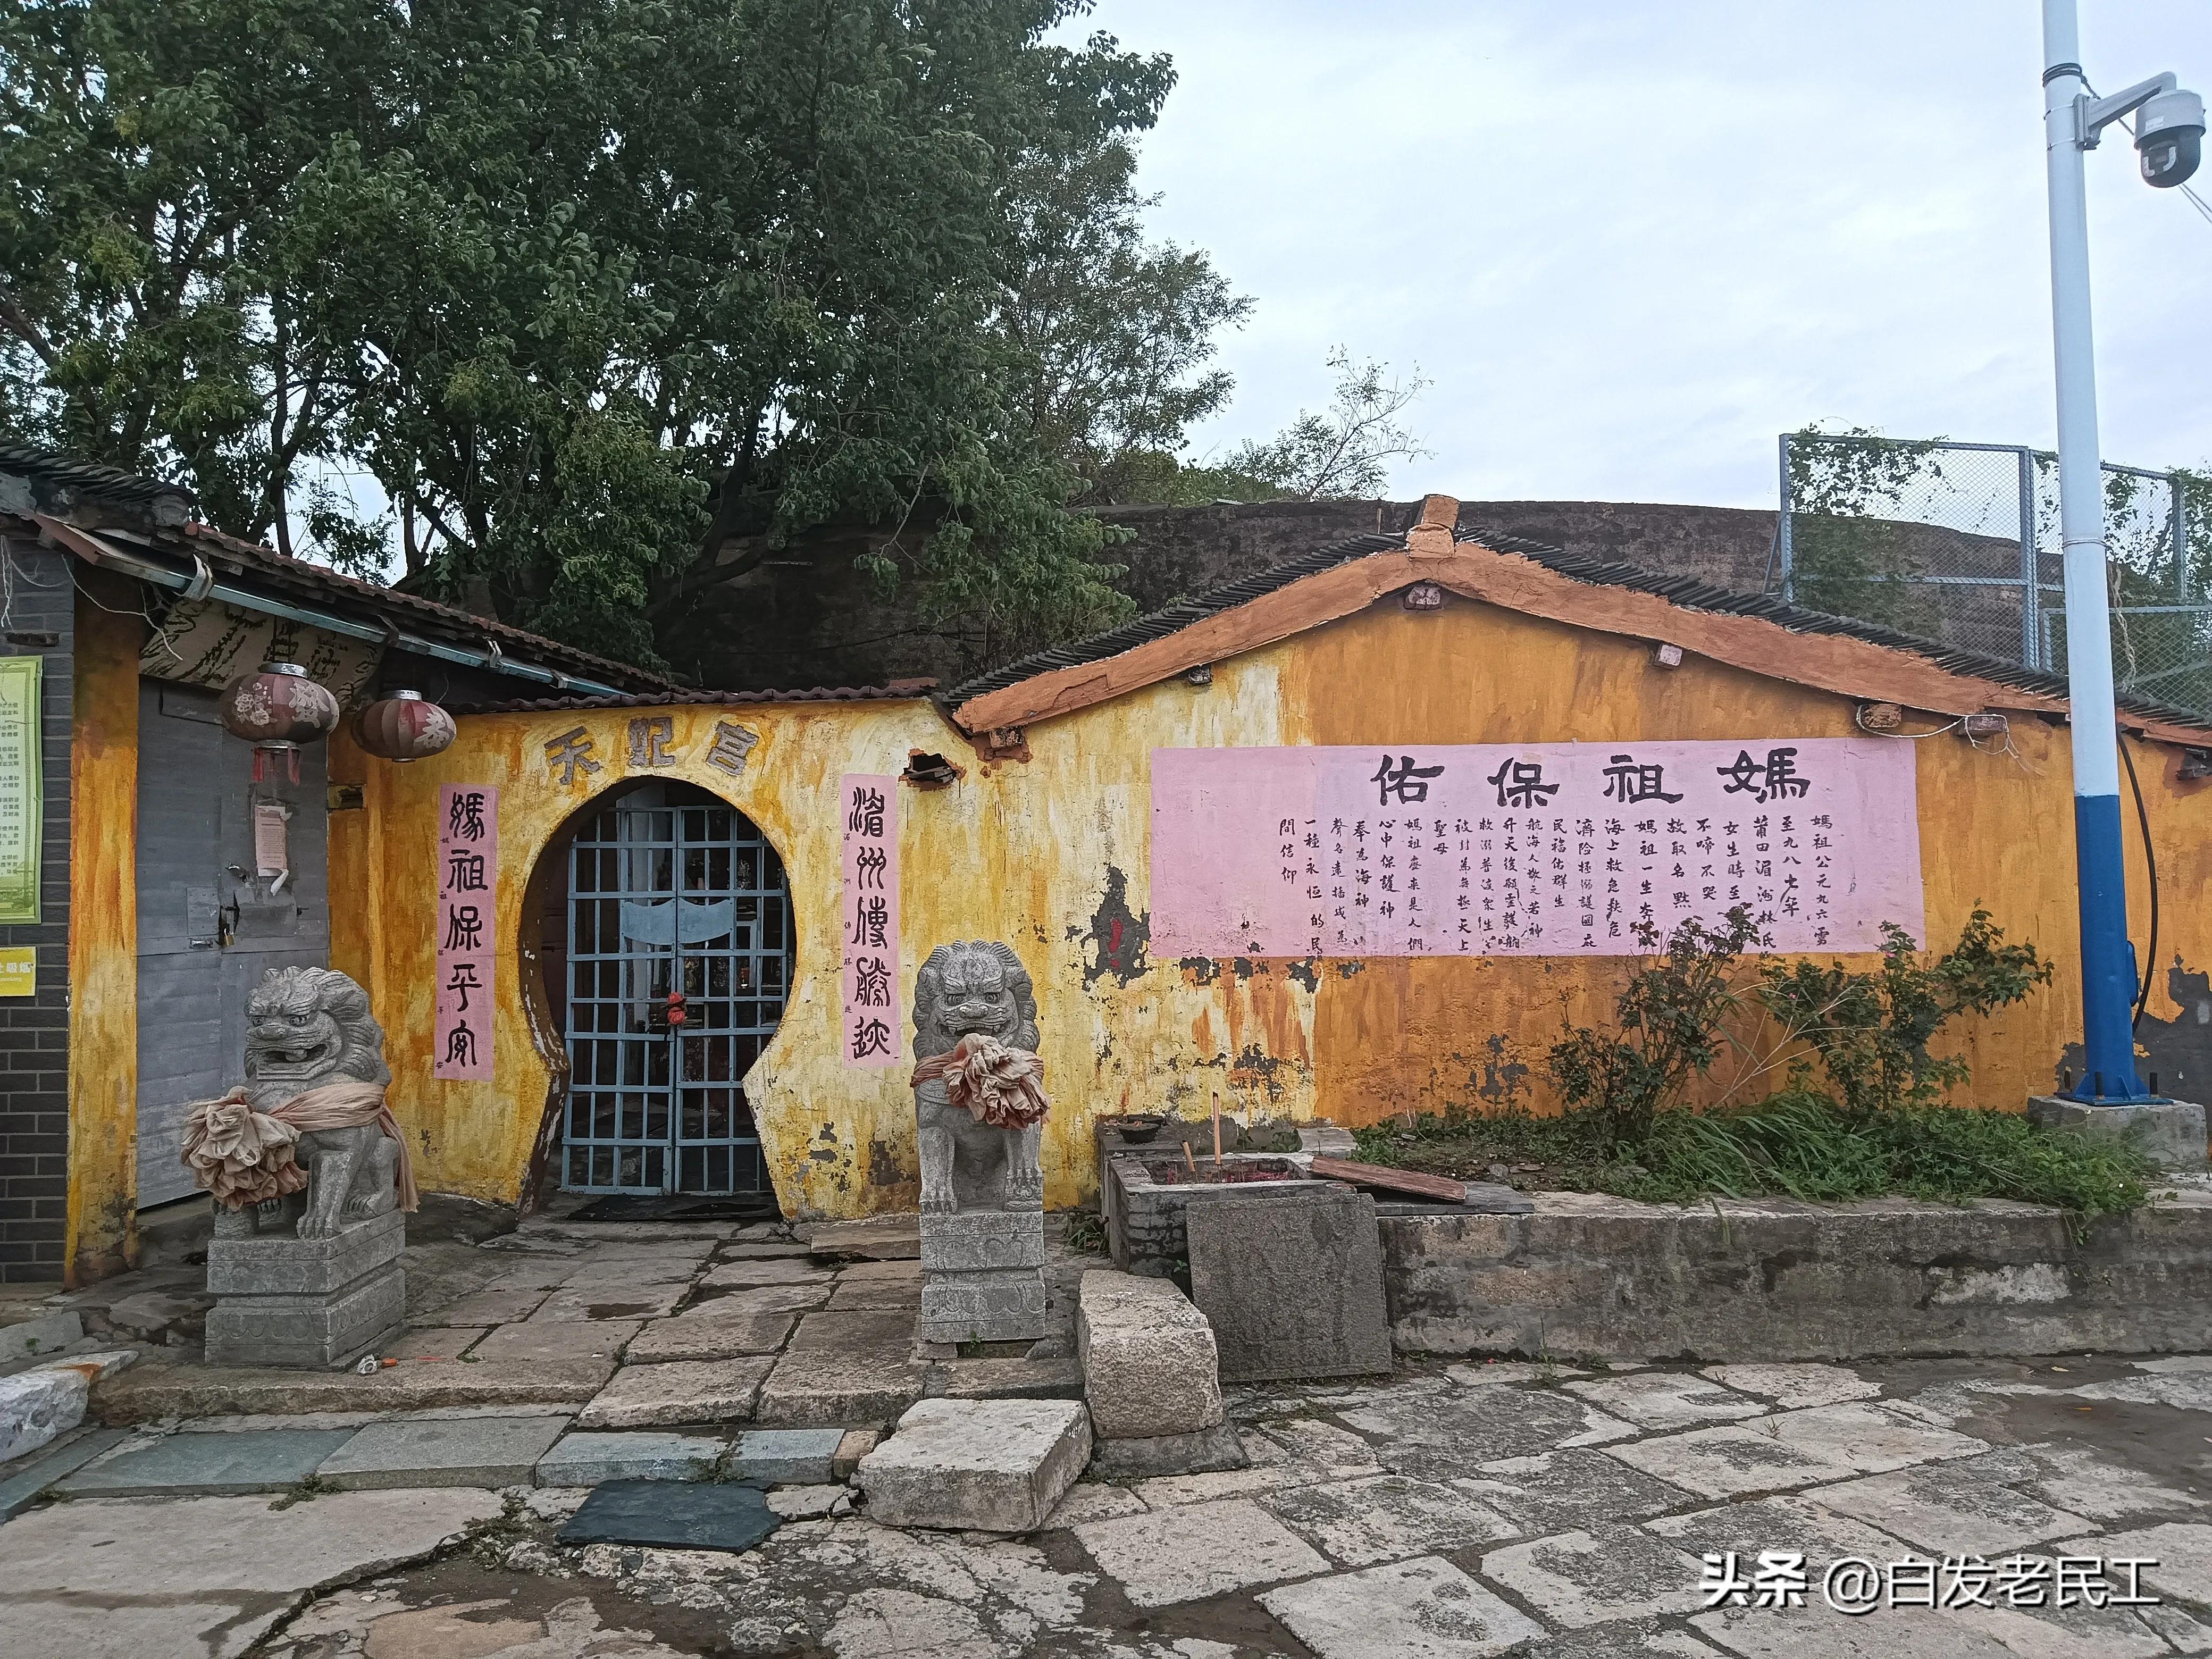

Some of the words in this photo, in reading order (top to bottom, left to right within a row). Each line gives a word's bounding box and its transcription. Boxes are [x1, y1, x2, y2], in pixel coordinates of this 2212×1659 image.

[1370, 747, 1810, 809] 媽祖保佑
[1280, 819, 1297, 884] 間信仰
[1379, 820, 1400, 919] 心中保護神
[1434, 820, 1448, 854] 聖母
[1696, 818, 1716, 900] 不啼不哭
